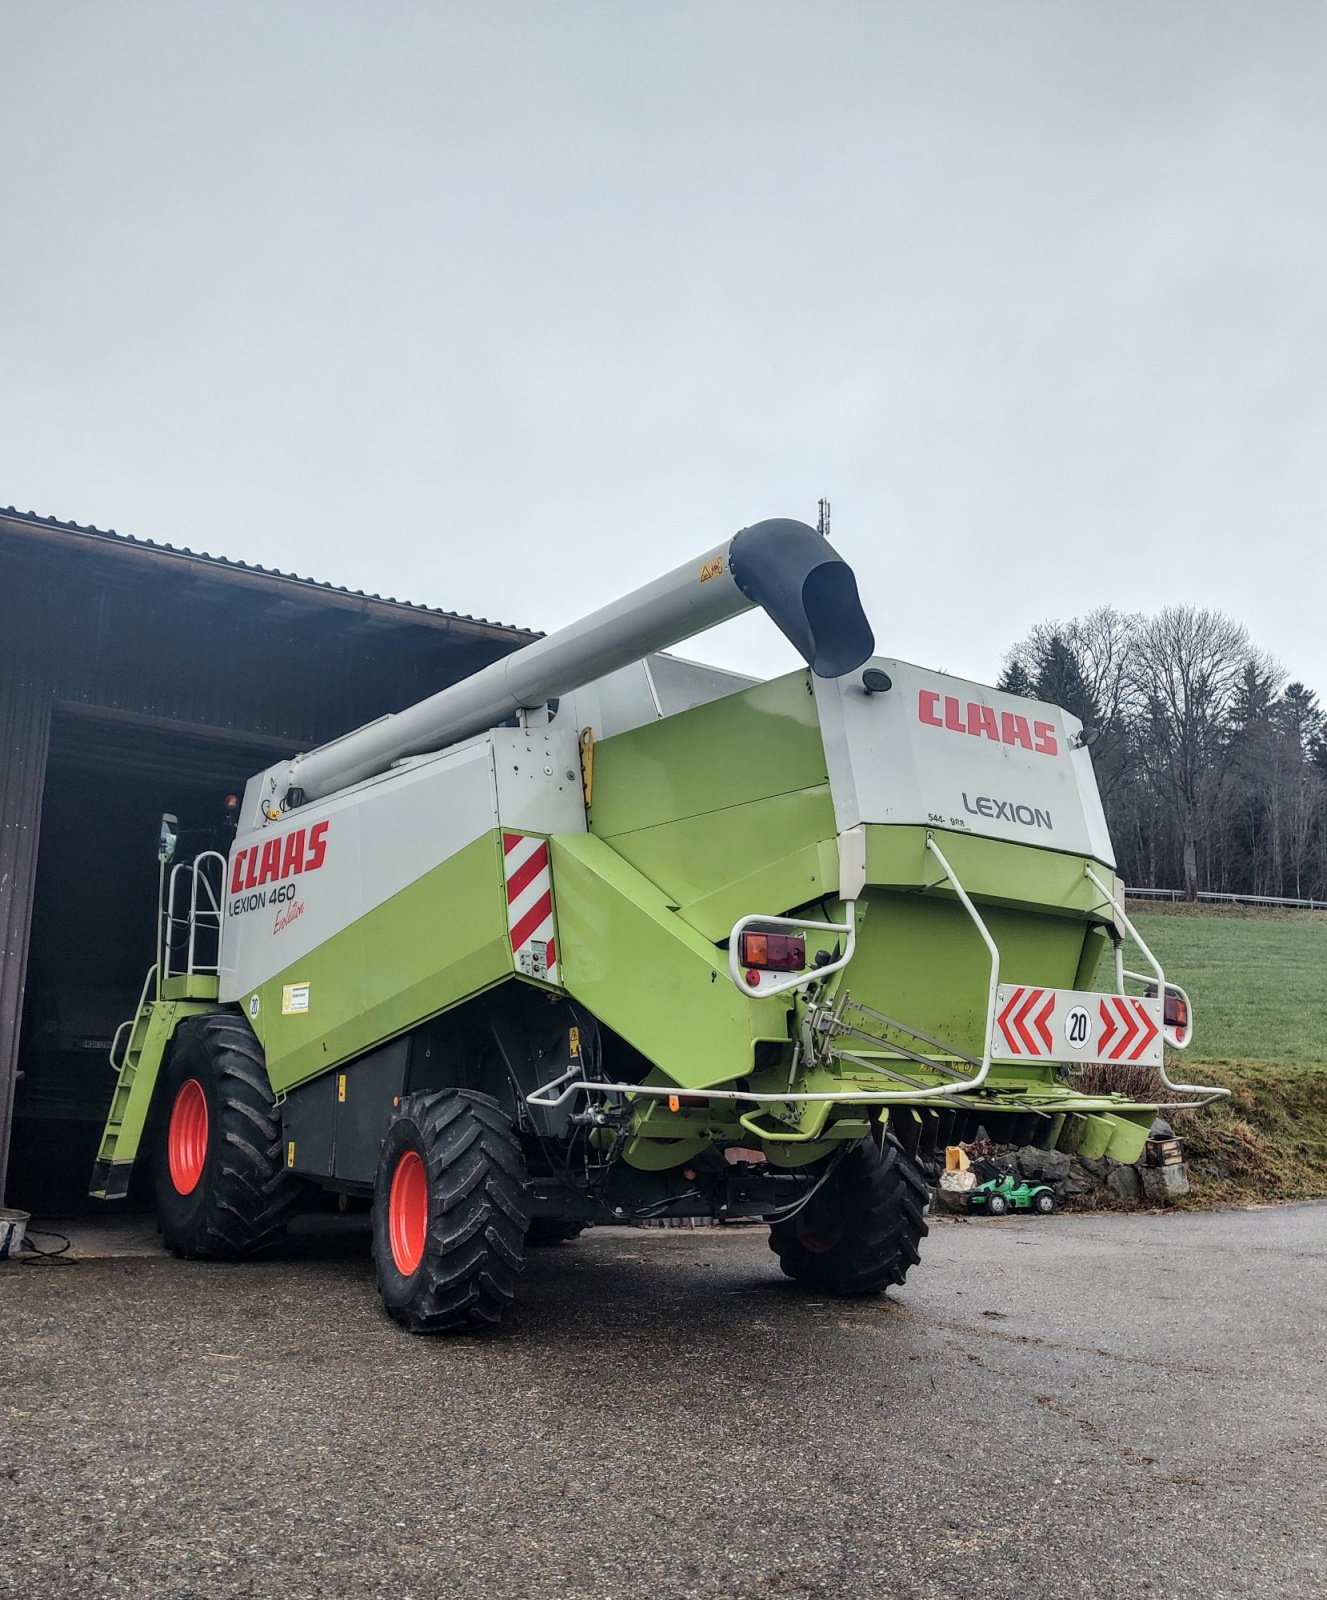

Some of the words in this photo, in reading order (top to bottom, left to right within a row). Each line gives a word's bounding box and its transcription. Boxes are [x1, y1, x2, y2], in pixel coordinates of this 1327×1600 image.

[918, 689, 1057, 756] CLAAS
[961, 792, 1053, 830] LEXION
[231, 820, 329, 894] CLAAS
[229, 891, 266, 917] LEXION
[268, 883, 296, 905] 460
[1069, 1013, 1087, 1042] 20
